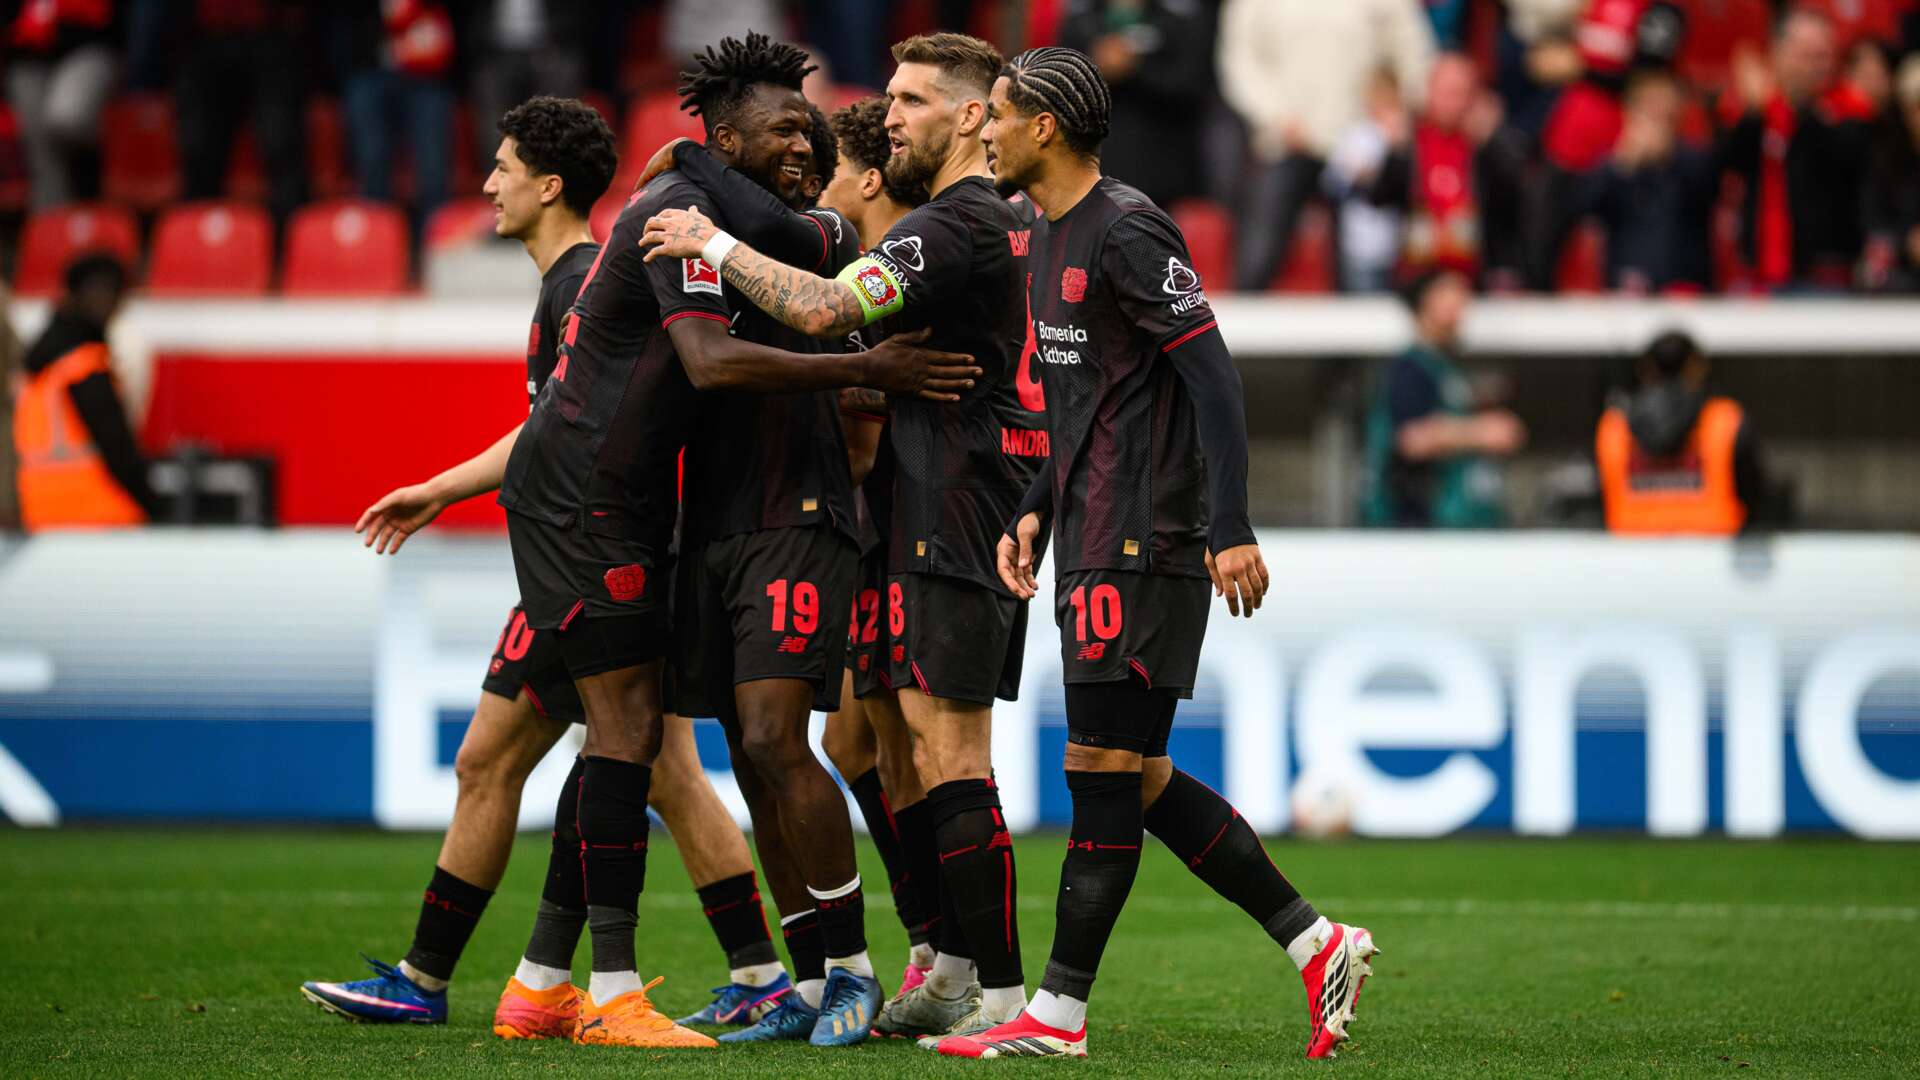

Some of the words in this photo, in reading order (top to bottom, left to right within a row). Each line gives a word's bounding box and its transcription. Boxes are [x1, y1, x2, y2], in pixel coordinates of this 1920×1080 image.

[868, 252, 911, 292] NIEDAX
[766, 578, 820, 635] 19
[888, 581, 905, 637] 8
[1069, 583, 1123, 642] 10
